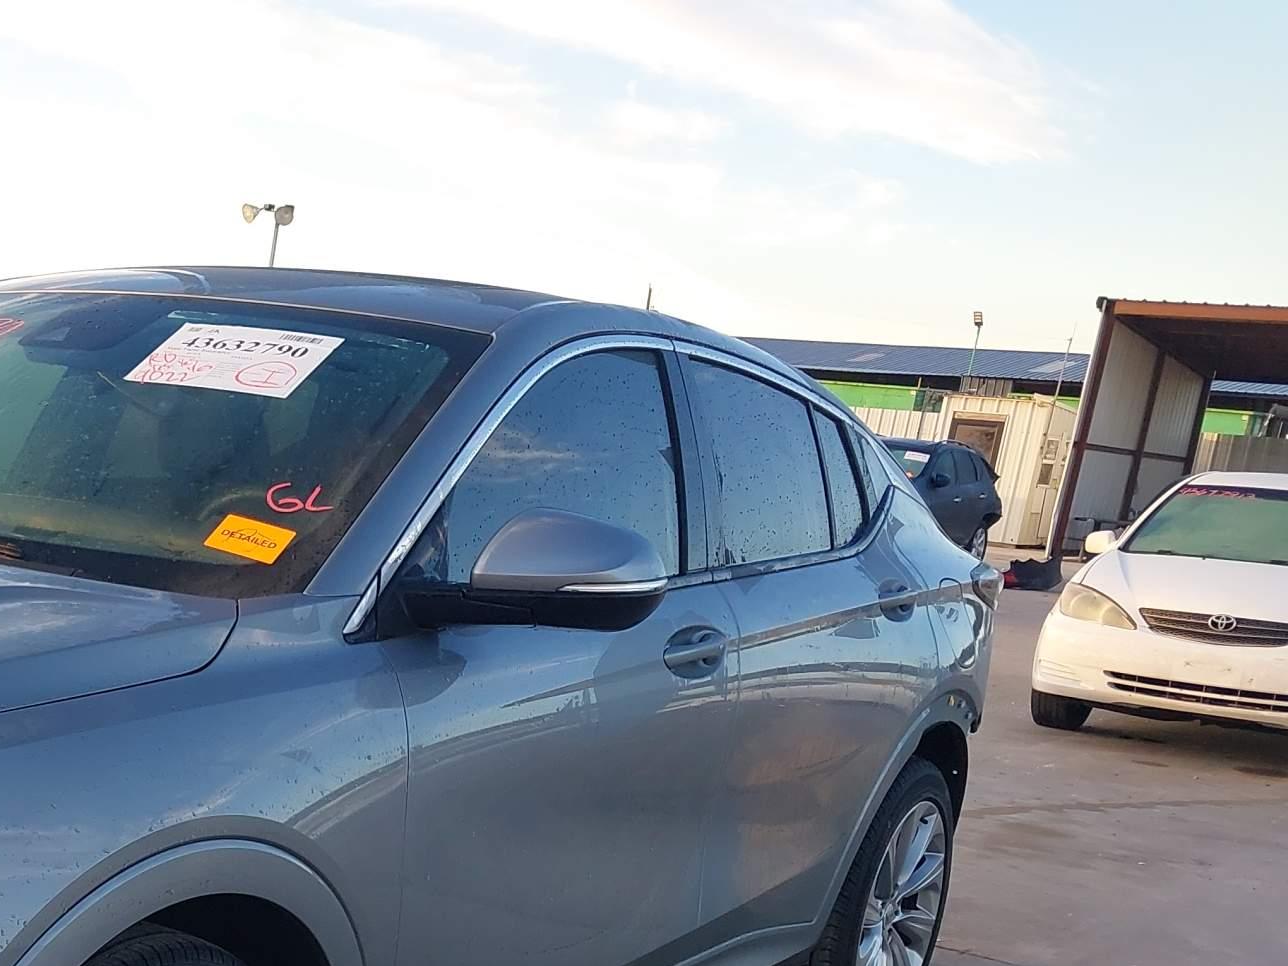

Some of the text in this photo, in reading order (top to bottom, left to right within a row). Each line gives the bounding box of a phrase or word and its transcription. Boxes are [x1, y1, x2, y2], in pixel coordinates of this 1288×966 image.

[182, 337, 309, 358] 43632790
[266, 482, 334, 513] GL
[220, 529, 278, 550] DETAILED
